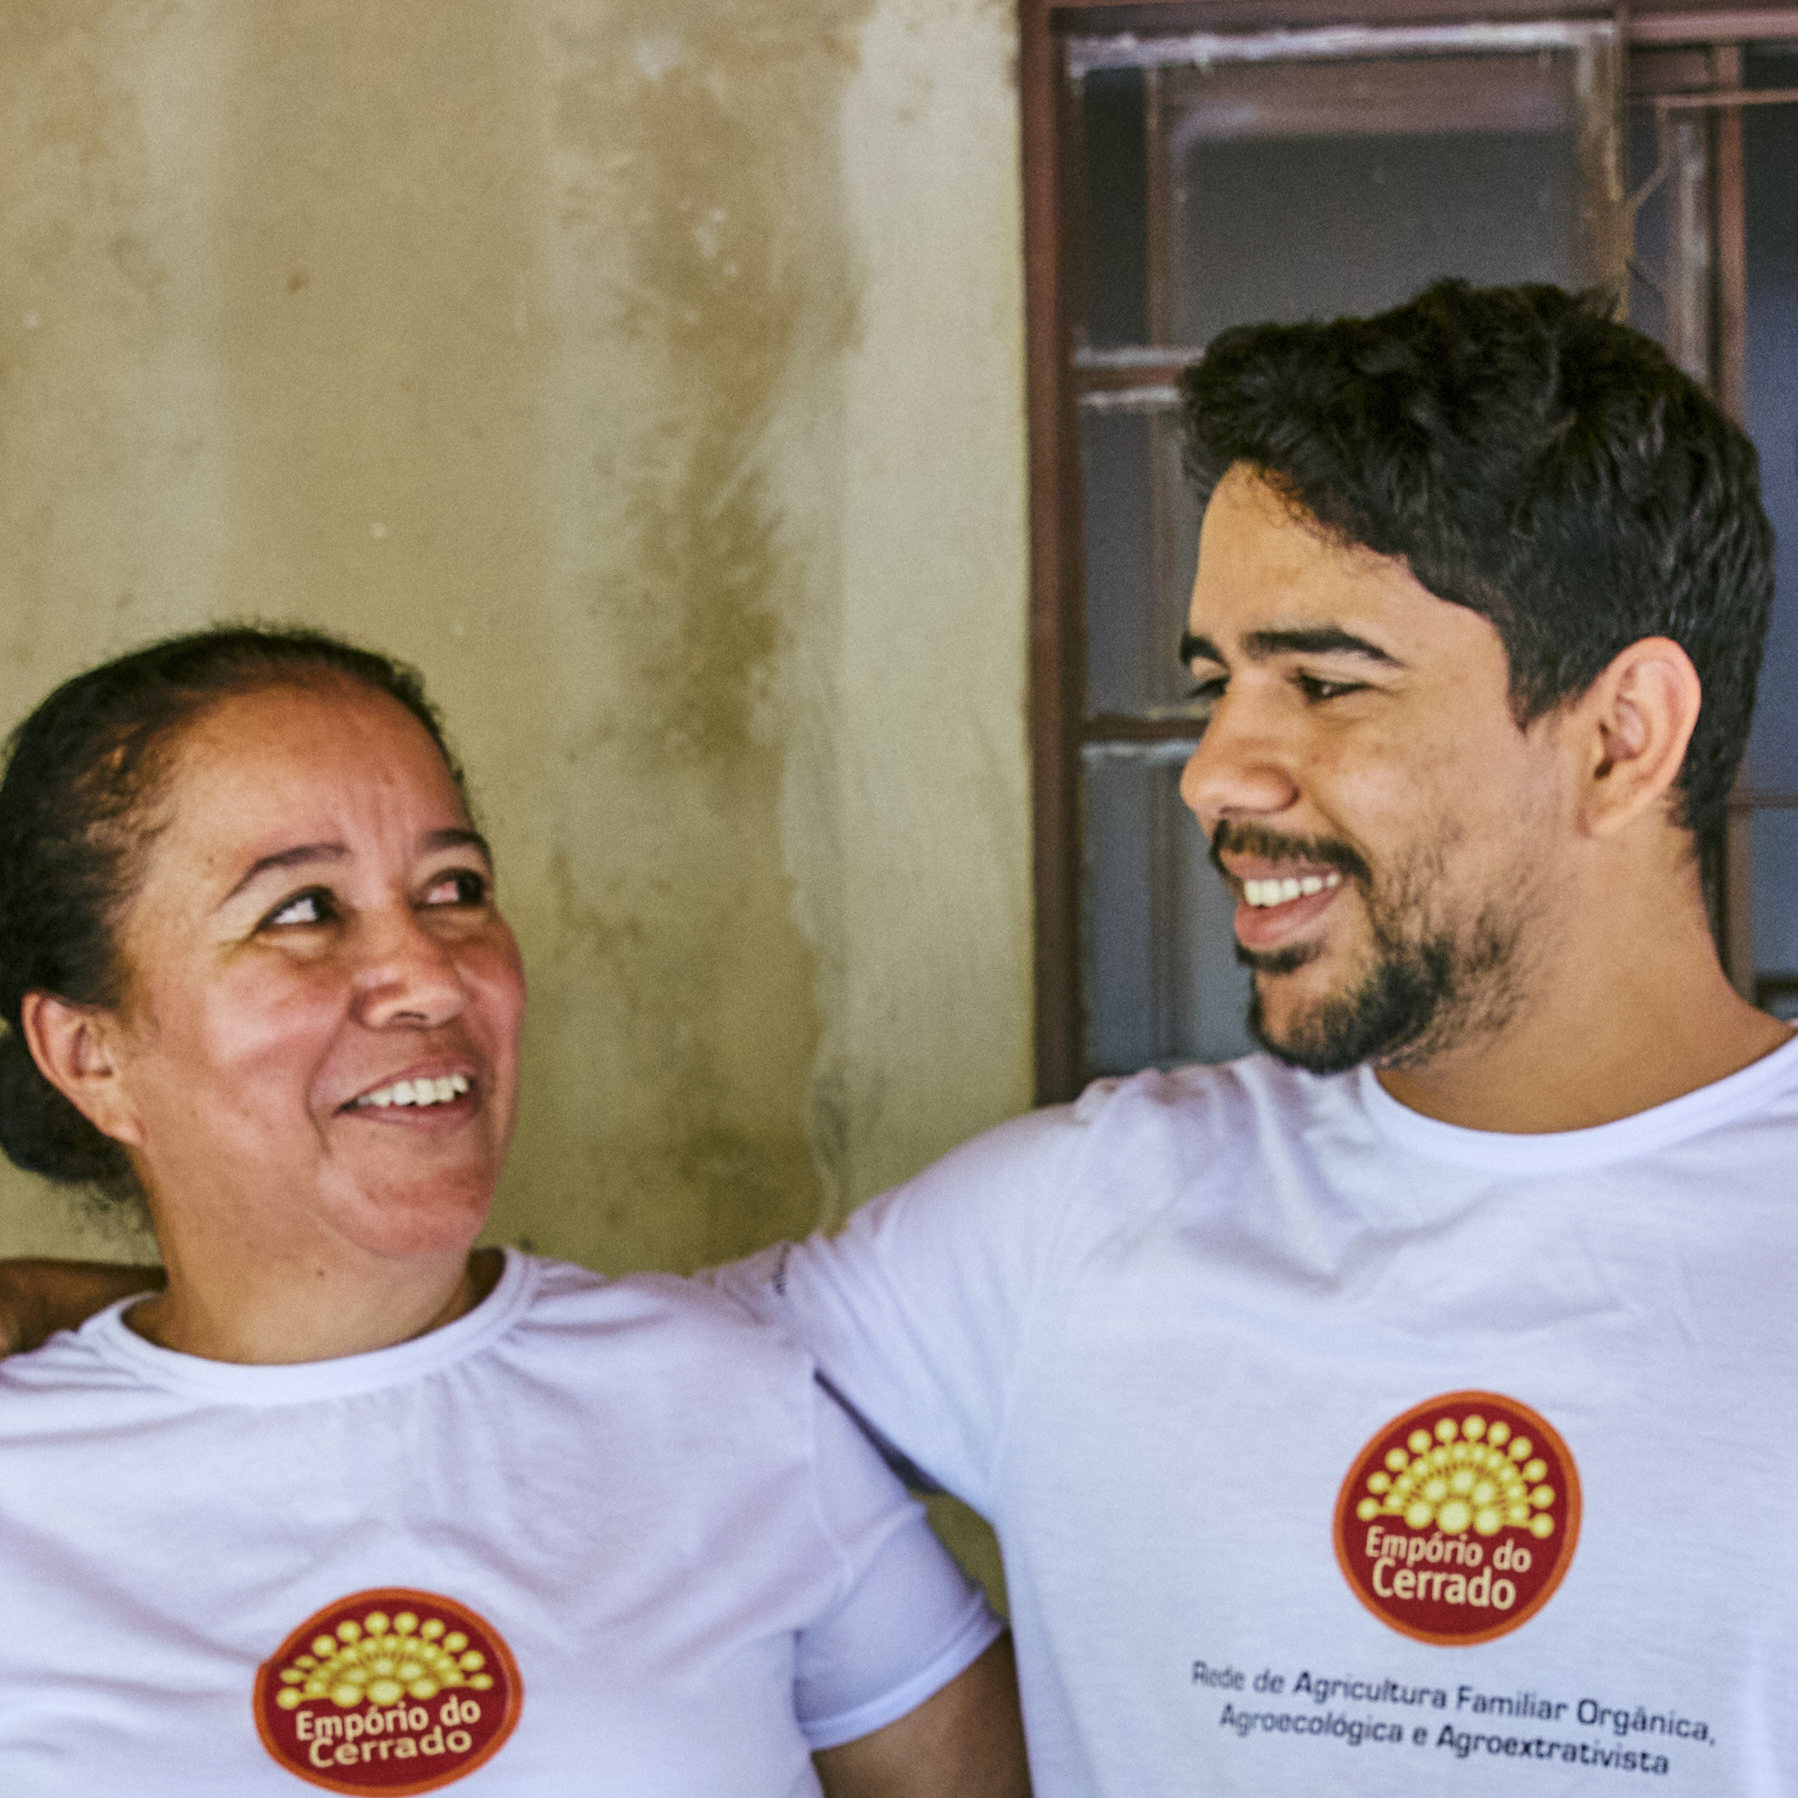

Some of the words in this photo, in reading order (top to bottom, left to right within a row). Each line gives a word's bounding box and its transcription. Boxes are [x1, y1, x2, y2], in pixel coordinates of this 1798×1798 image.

[1365, 1525, 1484, 1568] Empório
[1493, 1537, 1533, 1573] do
[1372, 1556, 1517, 1610] Cerrado
[296, 1701, 429, 1742] Empório
[440, 1694, 481, 1727] do
[1192, 1661, 1245, 1691] Rede
[1253, 1669, 1285, 1694] de
[1293, 1670, 1447, 1709] Agricultura
[1457, 1684, 1568, 1721] Familiar
[1576, 1698, 1716, 1747] Orgânica,
[309, 1725, 472, 1768] Cerrado
[1220, 1703, 1403, 1747] Agroecológica
[1412, 1725, 1428, 1746] e
[1436, 1723, 1670, 1776] Agroextrativista
